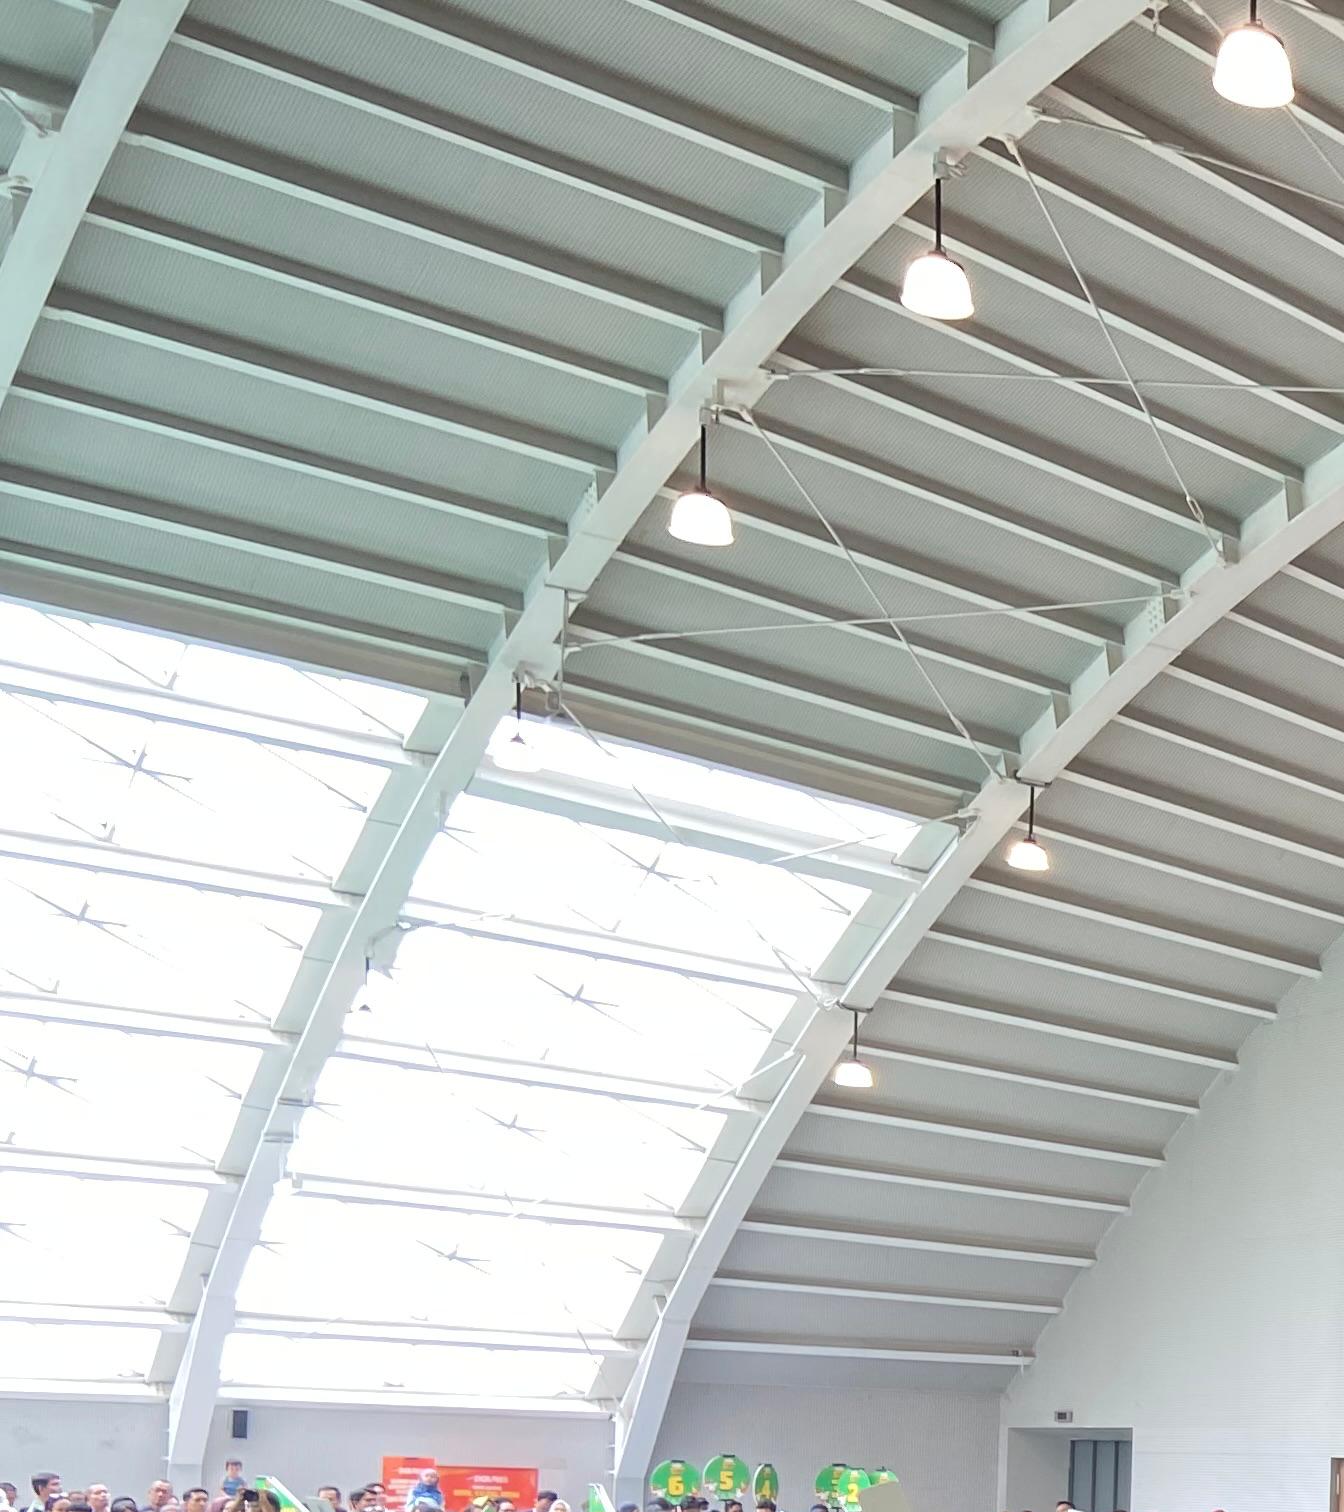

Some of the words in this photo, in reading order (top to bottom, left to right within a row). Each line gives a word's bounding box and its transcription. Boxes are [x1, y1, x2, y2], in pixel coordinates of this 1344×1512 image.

[668, 1474, 685, 1497] 6
[719, 1470, 734, 1490] 5
[847, 1483, 859, 1504] 2
